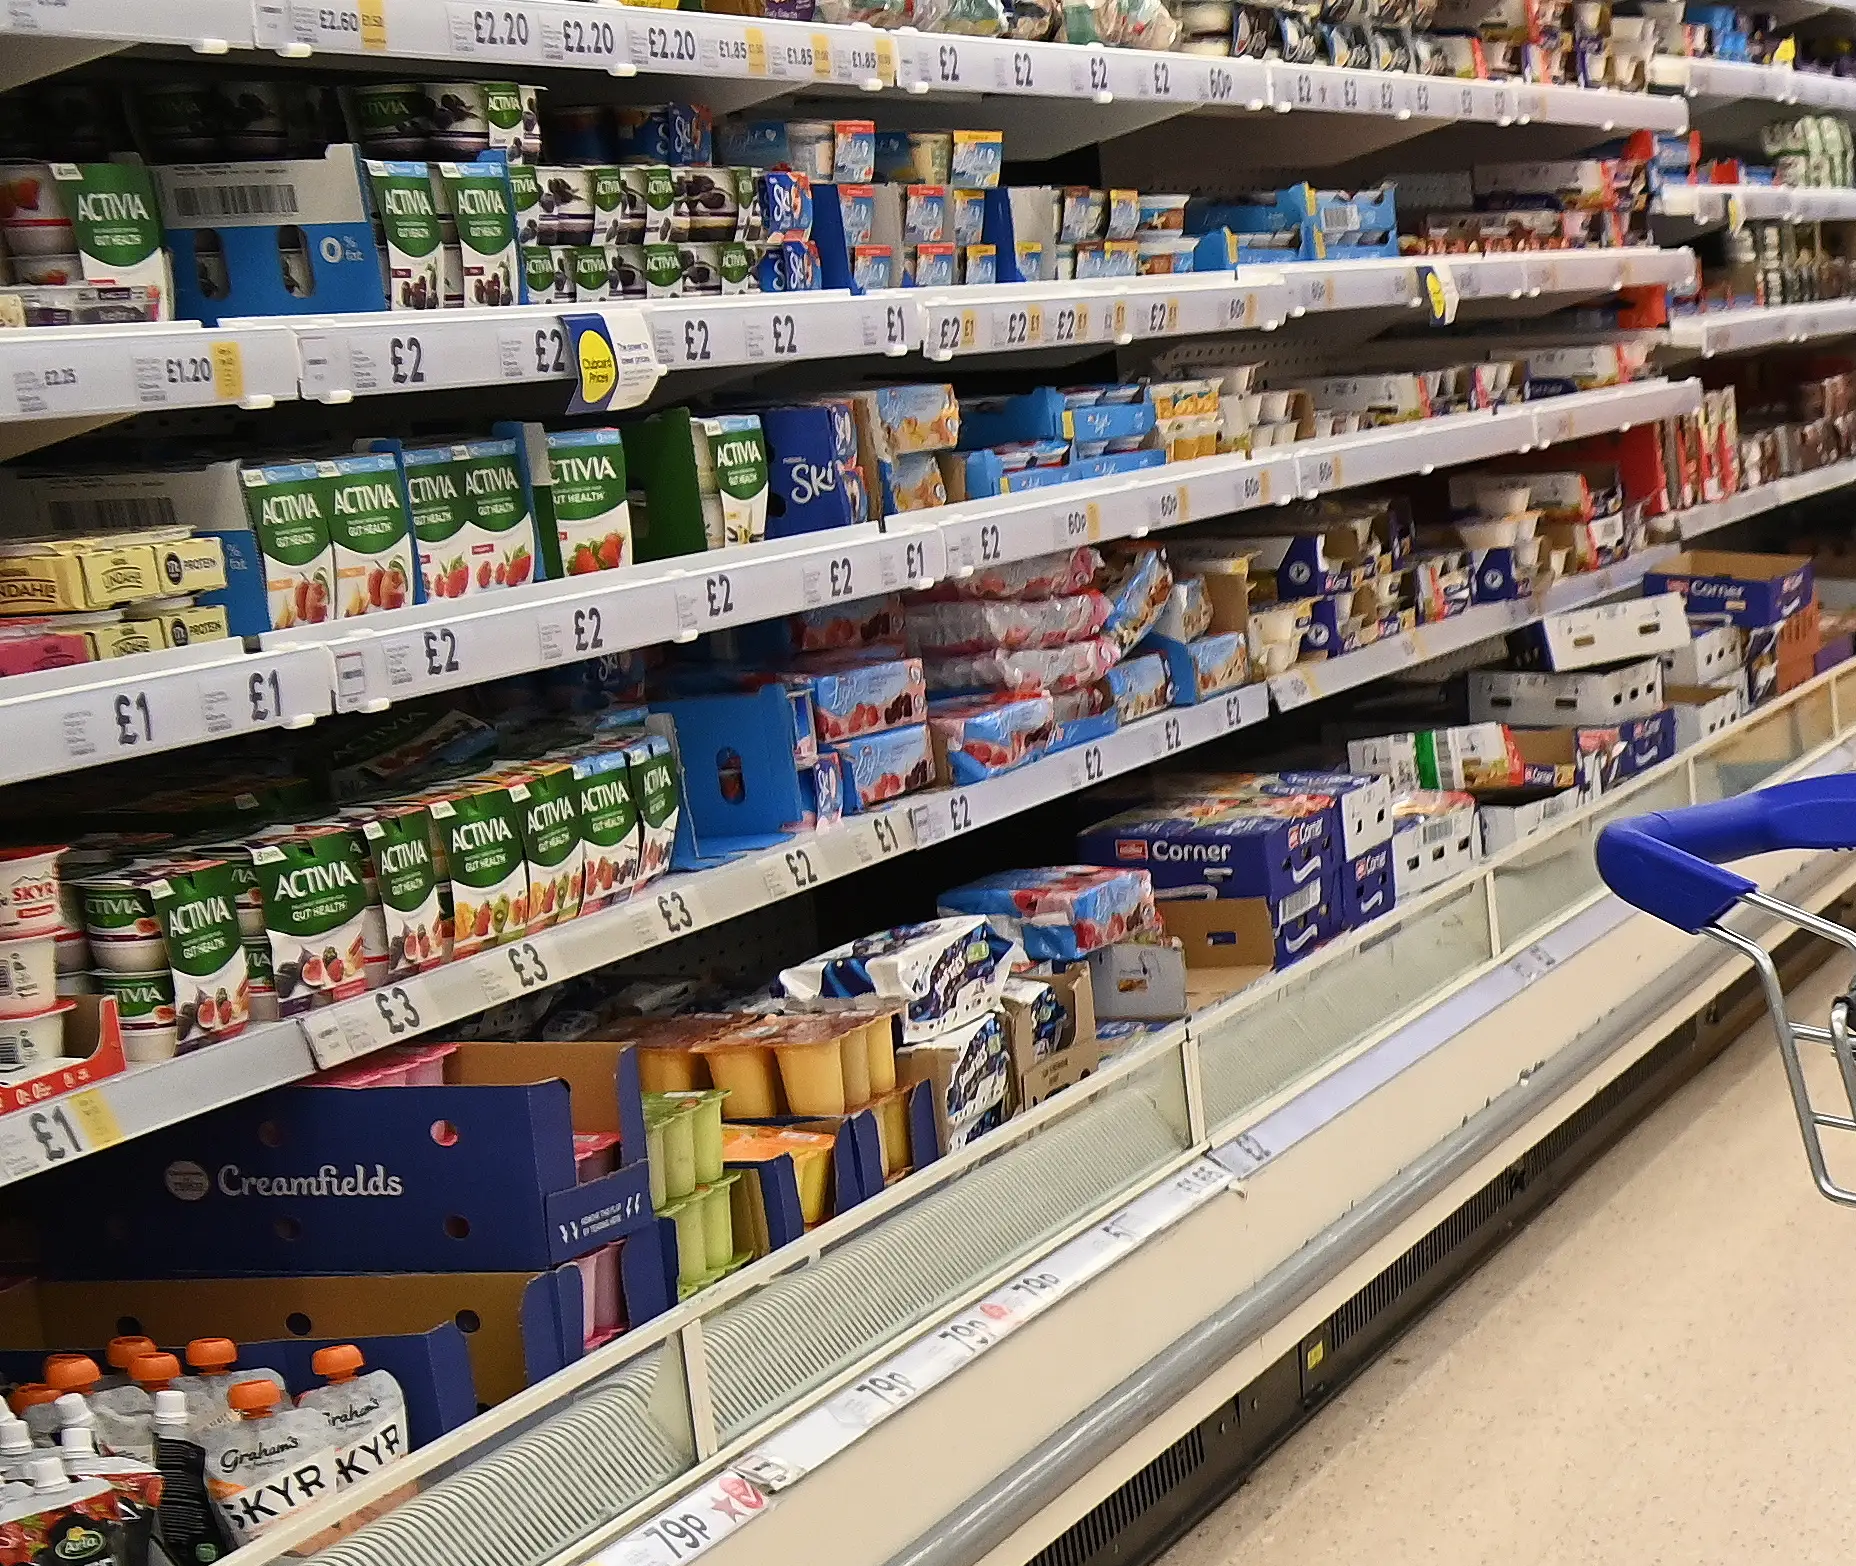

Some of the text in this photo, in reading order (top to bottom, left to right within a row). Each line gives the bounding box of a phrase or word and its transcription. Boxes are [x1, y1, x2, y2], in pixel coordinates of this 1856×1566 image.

[319, 9, 358, 32] £2.60
[473, 11, 528, 46] £2.20
[562, 20, 614, 55] £2.20
[648, 27, 696, 61] £2.20
[719, 40, 747, 60] £1.85
[786, 47, 813, 66] £1.85
[852, 51, 877, 70] £1.85
[938, 45, 960, 82] £2
[1014, 52, 1034, 88] £2
[1090, 56, 1109, 91] £2
[1153, 62, 1171, 95] £2
[77, 193, 151, 223] ACTIVIA
[384, 188, 433, 216] ACTIVIA
[457, 188, 505, 216] ACTIVIA
[772, 314, 798, 355] £2
[886, 305, 905, 343] £1
[939, 315, 961, 349] £2
[1007, 311, 1028, 344] £2
[1056, 309, 1075, 341] £2
[1149, 302, 1167, 332] £2
[535, 328, 566, 374] £2
[684, 319, 712, 362] £2
[166, 356, 212, 385] £1.20
[390, 337, 426, 385] £2
[550, 455, 617, 486] CTIVIA
[716, 439, 762, 469] ACTIVIA
[408, 474, 458, 501] CTIVIA
[464, 466, 519, 496] ACTIVIA
[791, 461, 837, 505] Ski
[262, 493, 323, 526] ACTIVIA
[333, 484, 401, 517] ACTIVIA
[1068, 512, 1087, 536] 60p
[907, 541, 926, 580] £1
[981, 524, 1002, 562] £2
[830, 555, 854, 597] £2
[706, 573, 734, 618] £2
[574, 606, 604, 653] £2
[423, 627, 460, 676] £2
[249, 669, 283, 722] £1
[1226, 696, 1242, 725] £2
[113, 691, 154, 747] £1
[1165, 718, 1182, 749] £2
[1085, 746, 1104, 782] £2
[527, 796, 575, 835] ACTIVIA
[580, 779, 631, 816] ACTIVIA
[950, 795, 972, 831] £2
[450, 816, 513, 855] ACTIVIA
[873, 817, 900, 854] £1
[1151, 839, 1232, 865] Corner
[380, 839, 429, 876] ACTIVIA
[783, 847, 818, 888] £2
[11, 880, 58, 904] SKYR
[274, 859, 358, 901] ACTIVIA
[168, 895, 234, 940] ACTIVIA
[291, 900, 348, 922] GUT HEALTH
[656, 889, 693, 934] £3
[507, 941, 549, 989] £3
[375, 985, 420, 1035] £3
[28, 1105, 83, 1162] £1
[217, 1163, 404, 1198] Creamfields
[938, 1318, 1001, 1355] 79p
[857, 1369, 917, 1404] 79p
[323, 1396, 380, 1429] raham's
[220, 1435, 300, 1474] Graham's
[336, 1423, 403, 1486] KYR
[65, 1534, 99, 1556] Arla
[643, 1512, 714, 1560] 79p
